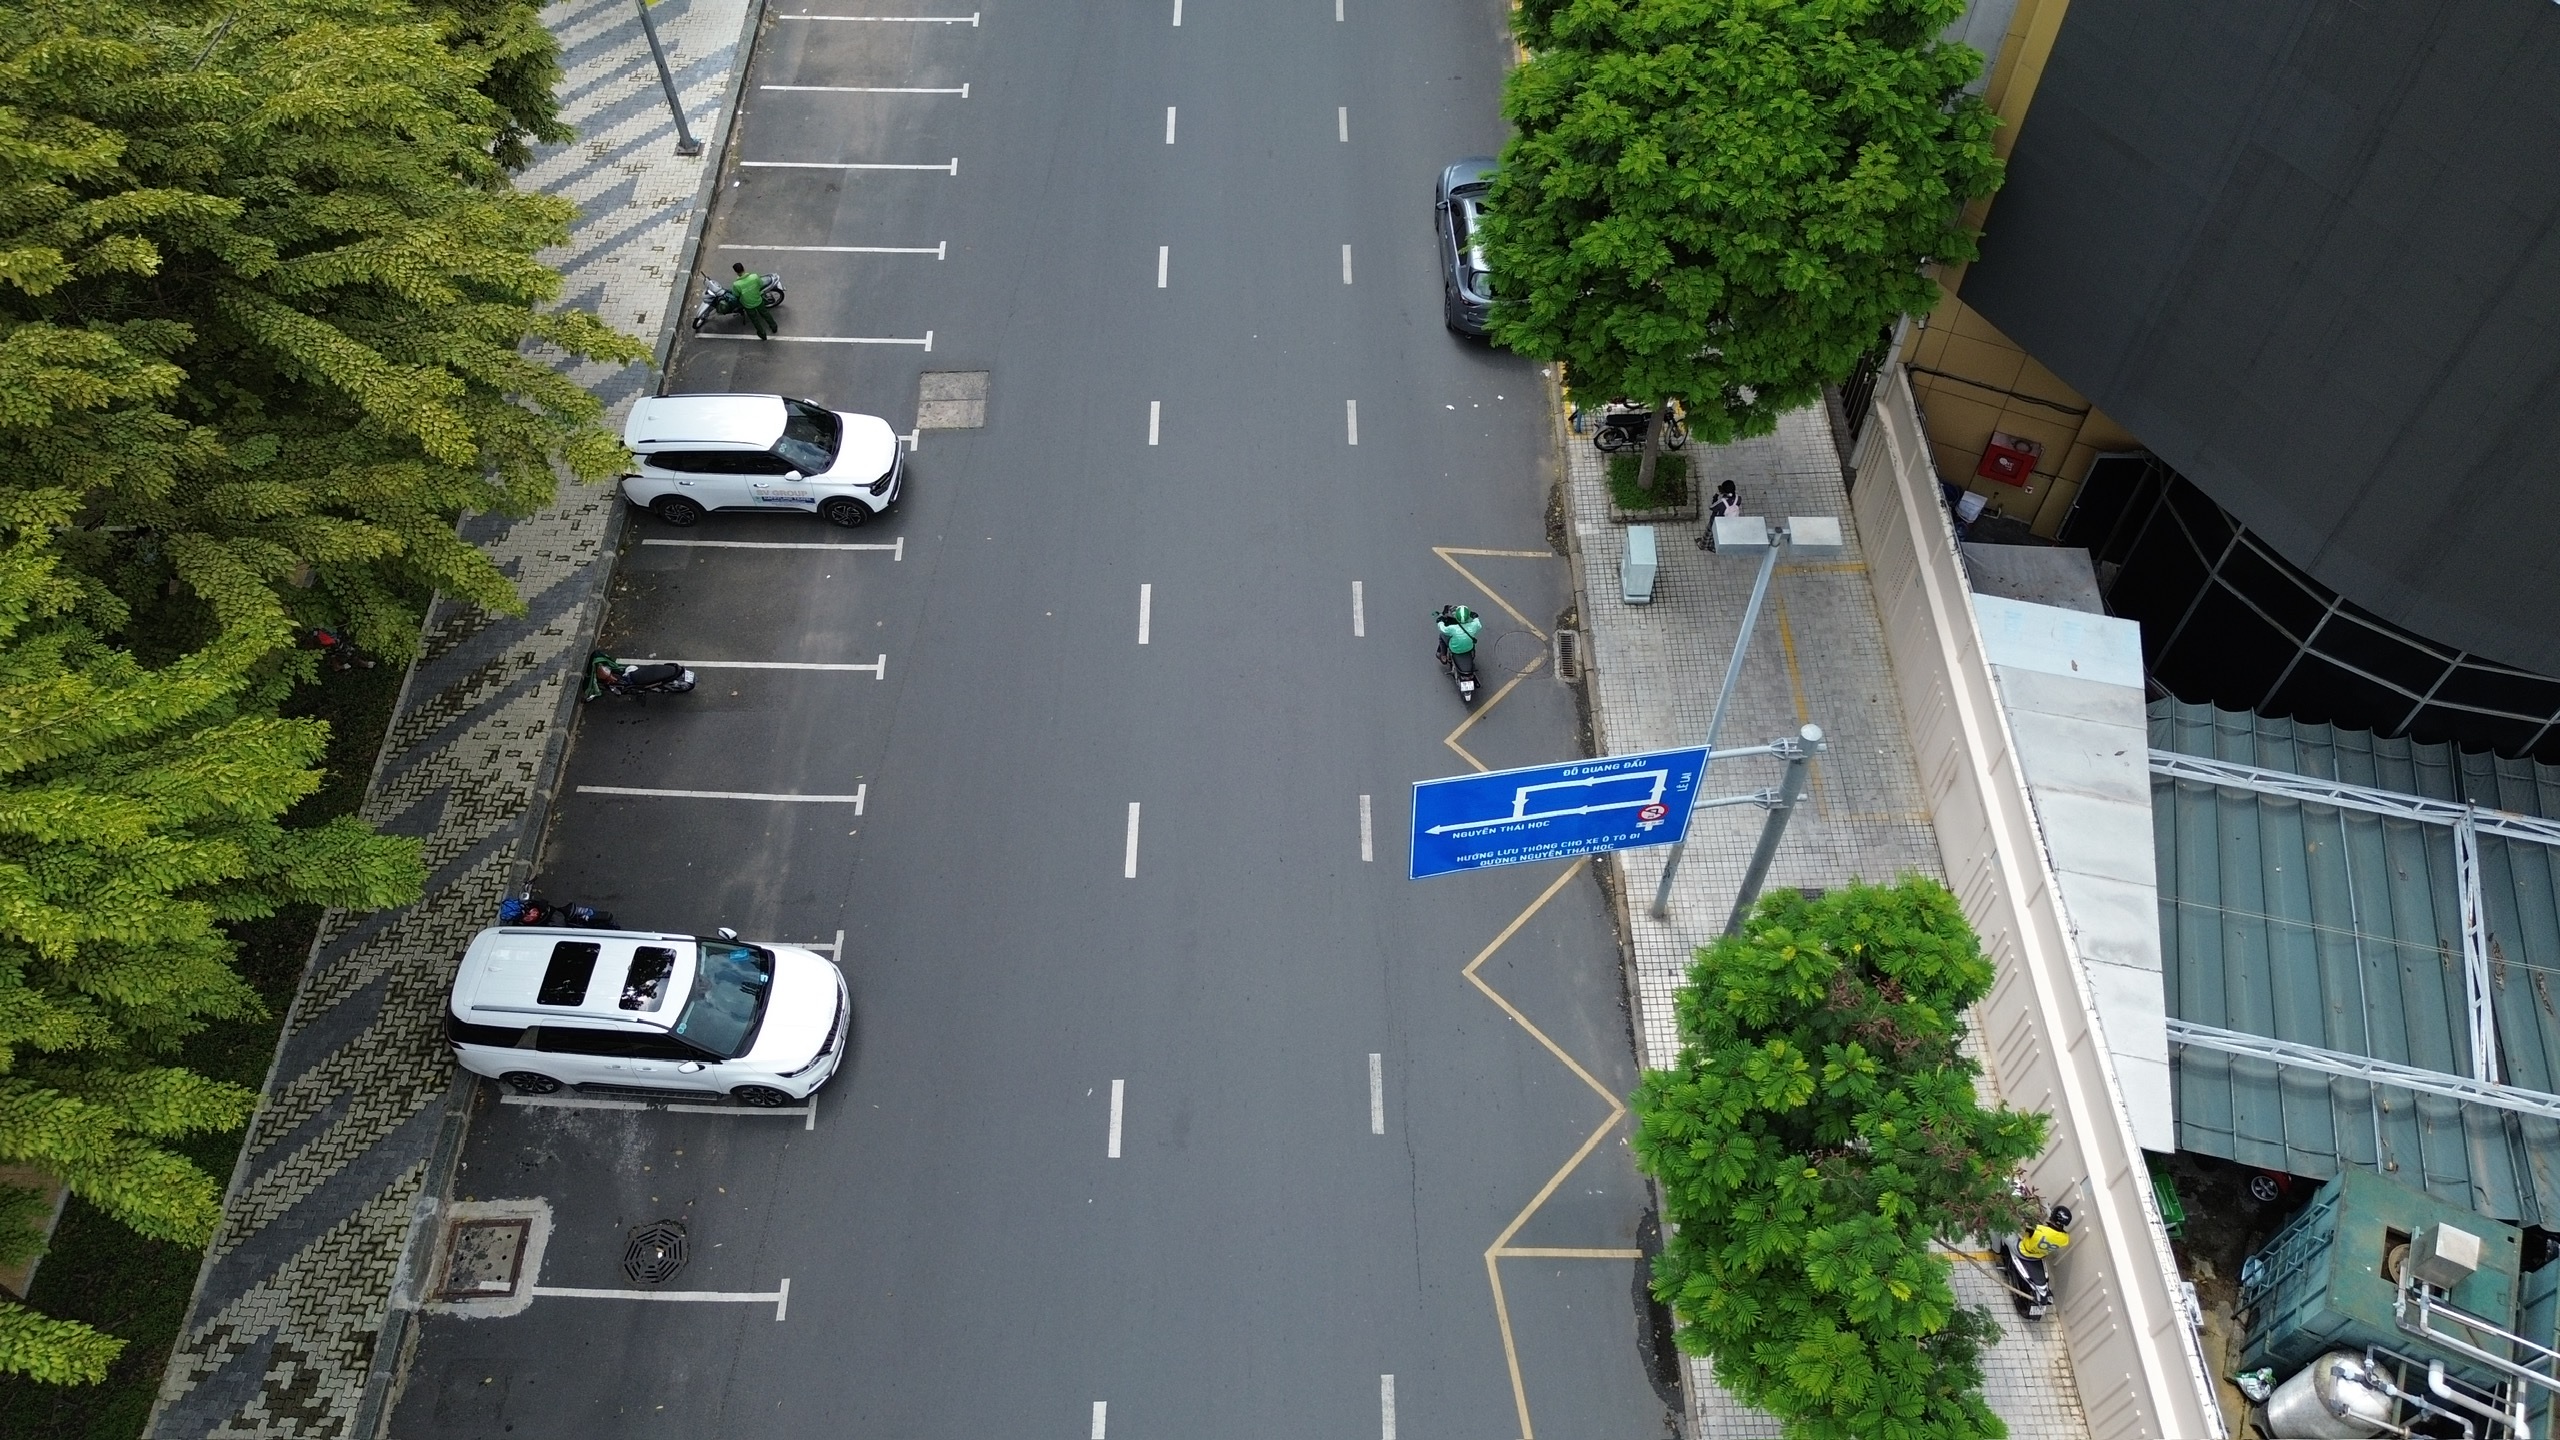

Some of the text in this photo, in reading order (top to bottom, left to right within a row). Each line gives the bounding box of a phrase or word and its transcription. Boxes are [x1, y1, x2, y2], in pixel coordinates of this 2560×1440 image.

[1582, 763, 1620, 774] QUANG
[1680, 772, 1692, 783] LAI
[1452, 820, 1550, 839] NGUYỄN THÁI HỌC
[1497, 848, 1519, 856] LƯU
[1522, 842, 1558, 853] THÔNG
[1561, 839, 1582, 848] CHO
[1586, 837, 1599, 845] XE
[1613, 833, 1626, 841] TÔ
[1566, 845, 1590, 855] THÁI
